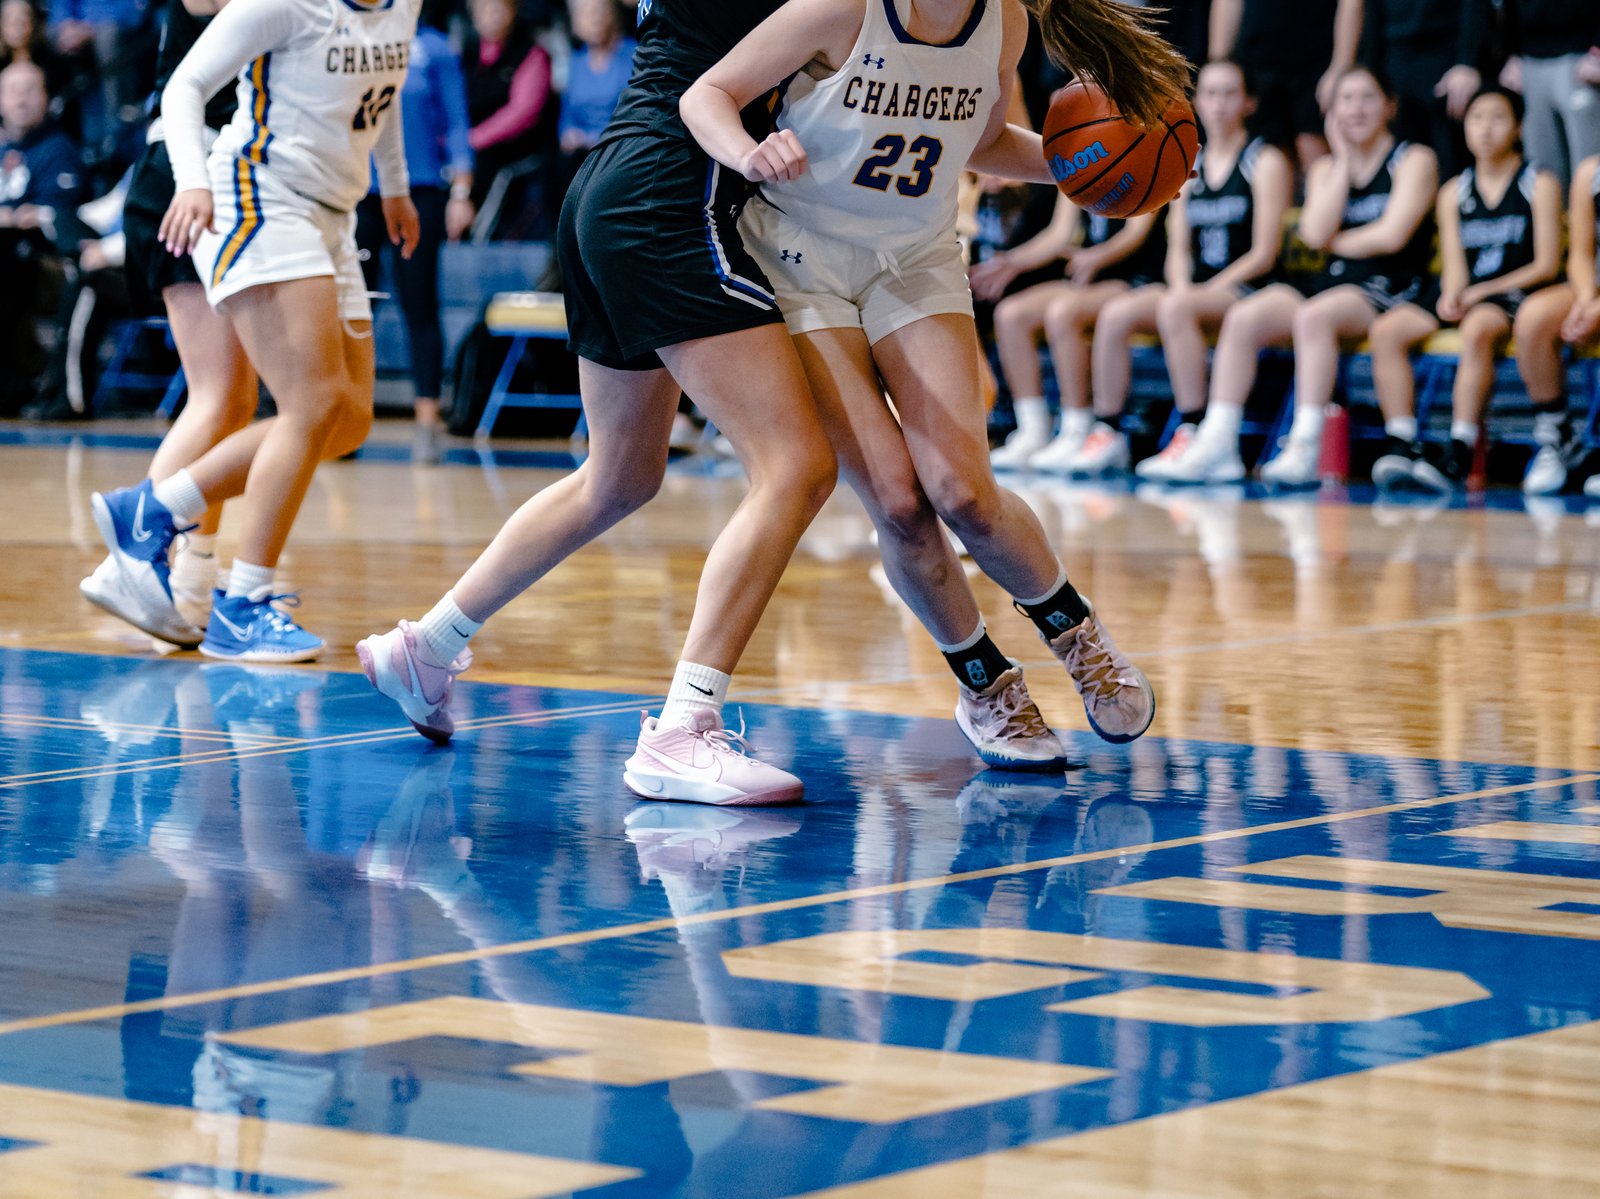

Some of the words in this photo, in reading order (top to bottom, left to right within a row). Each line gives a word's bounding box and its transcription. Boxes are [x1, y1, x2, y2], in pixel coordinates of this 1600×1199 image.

[843, 76, 983, 121] CHARGERS
[851, 134, 944, 198] 23
[1048, 140, 1109, 182] ilson
